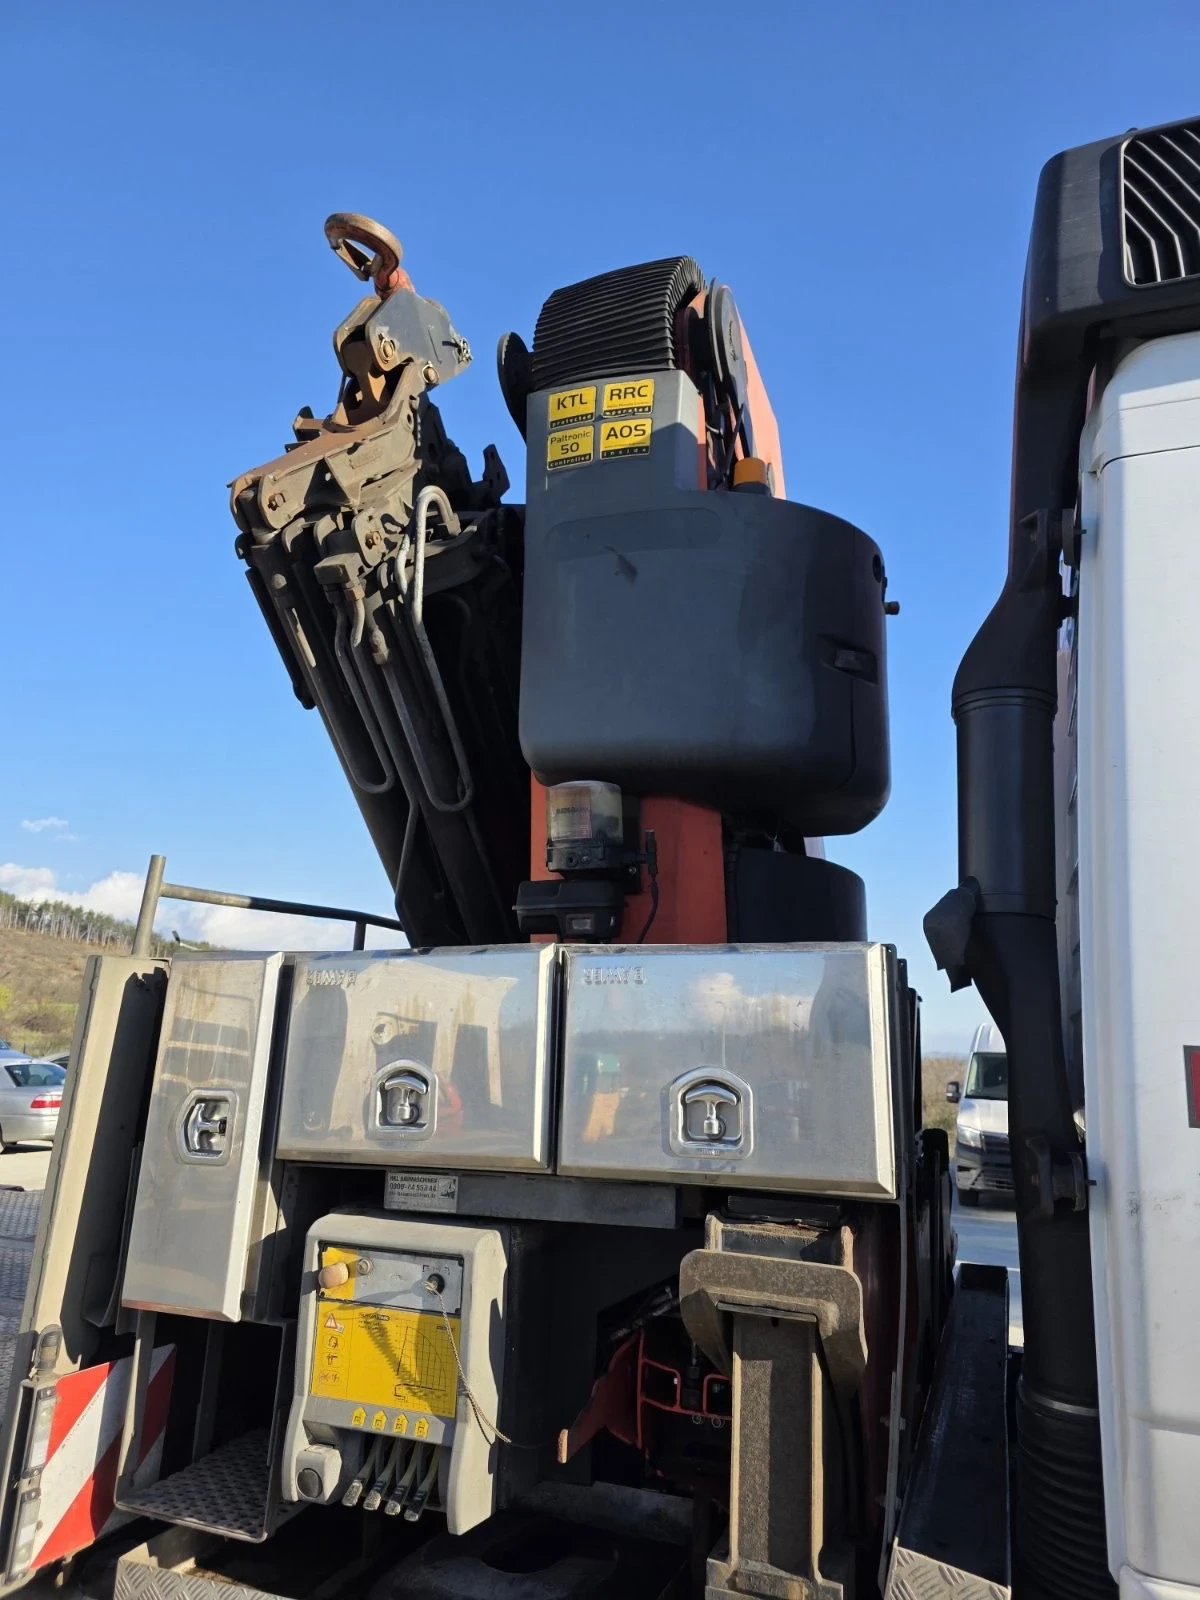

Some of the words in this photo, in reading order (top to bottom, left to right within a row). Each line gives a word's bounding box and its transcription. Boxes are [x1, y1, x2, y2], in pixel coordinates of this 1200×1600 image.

[609, 385, 649, 401] RRC
[557, 393, 588, 411] KTL
[551, 414, 592, 428] protected
[550, 431, 592, 446] Paltronic
[605, 423, 647, 441] AOS
[560, 442, 580, 456] 50
[549, 455, 591, 468] controlled
